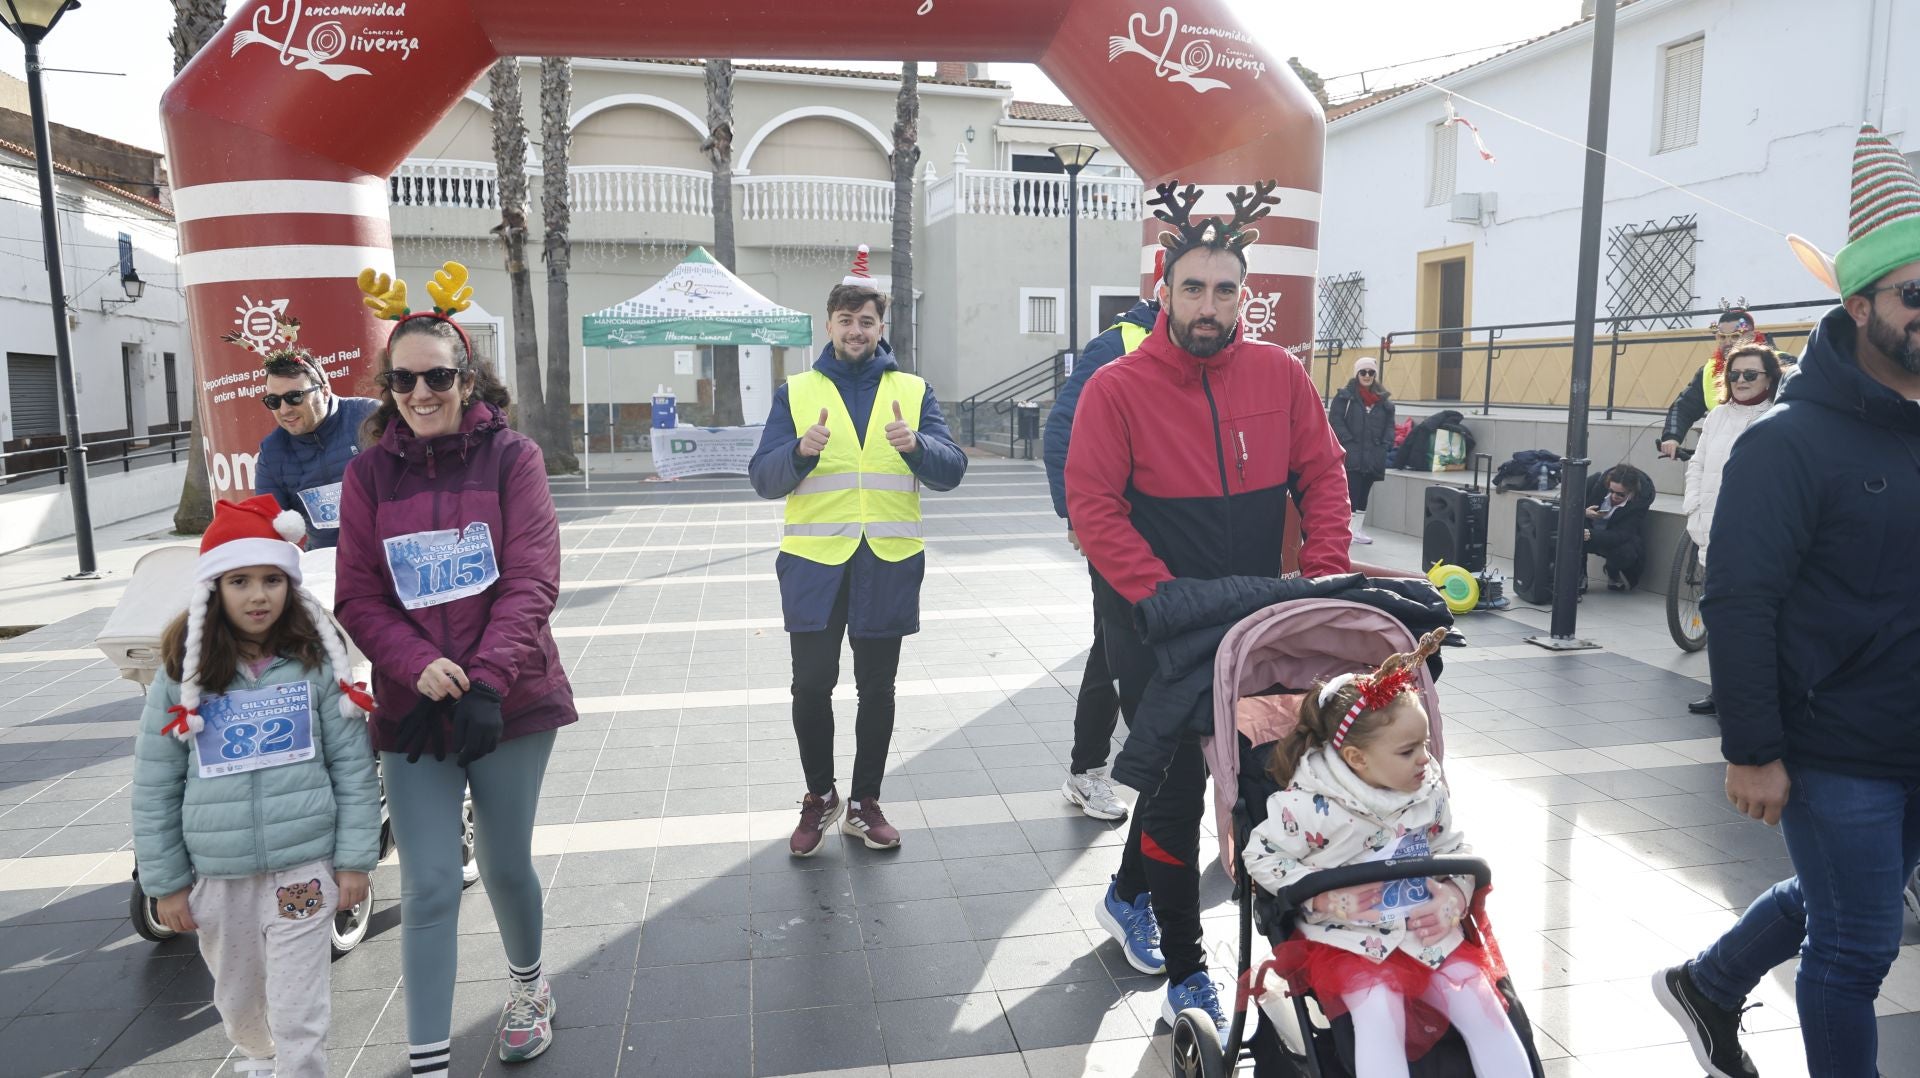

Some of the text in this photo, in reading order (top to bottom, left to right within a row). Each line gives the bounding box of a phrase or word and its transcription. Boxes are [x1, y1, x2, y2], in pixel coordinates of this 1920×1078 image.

[362, 27, 405, 36] Comarca de
[594, 318, 656, 326] MANCOMUNIDAD
[715, 316, 752, 324] COMARCA
[764, 316, 801, 324] OLIVENZA
[202, 371, 250, 392] Deportistas
[338, 347, 361, 362] Real
[214, 391, 236, 404] entre
[415, 550, 486, 598] 115
[279, 684, 307, 696] SAN
[241, 694, 308, 710] SILVESTRE
[220, 716, 295, 760] 82
